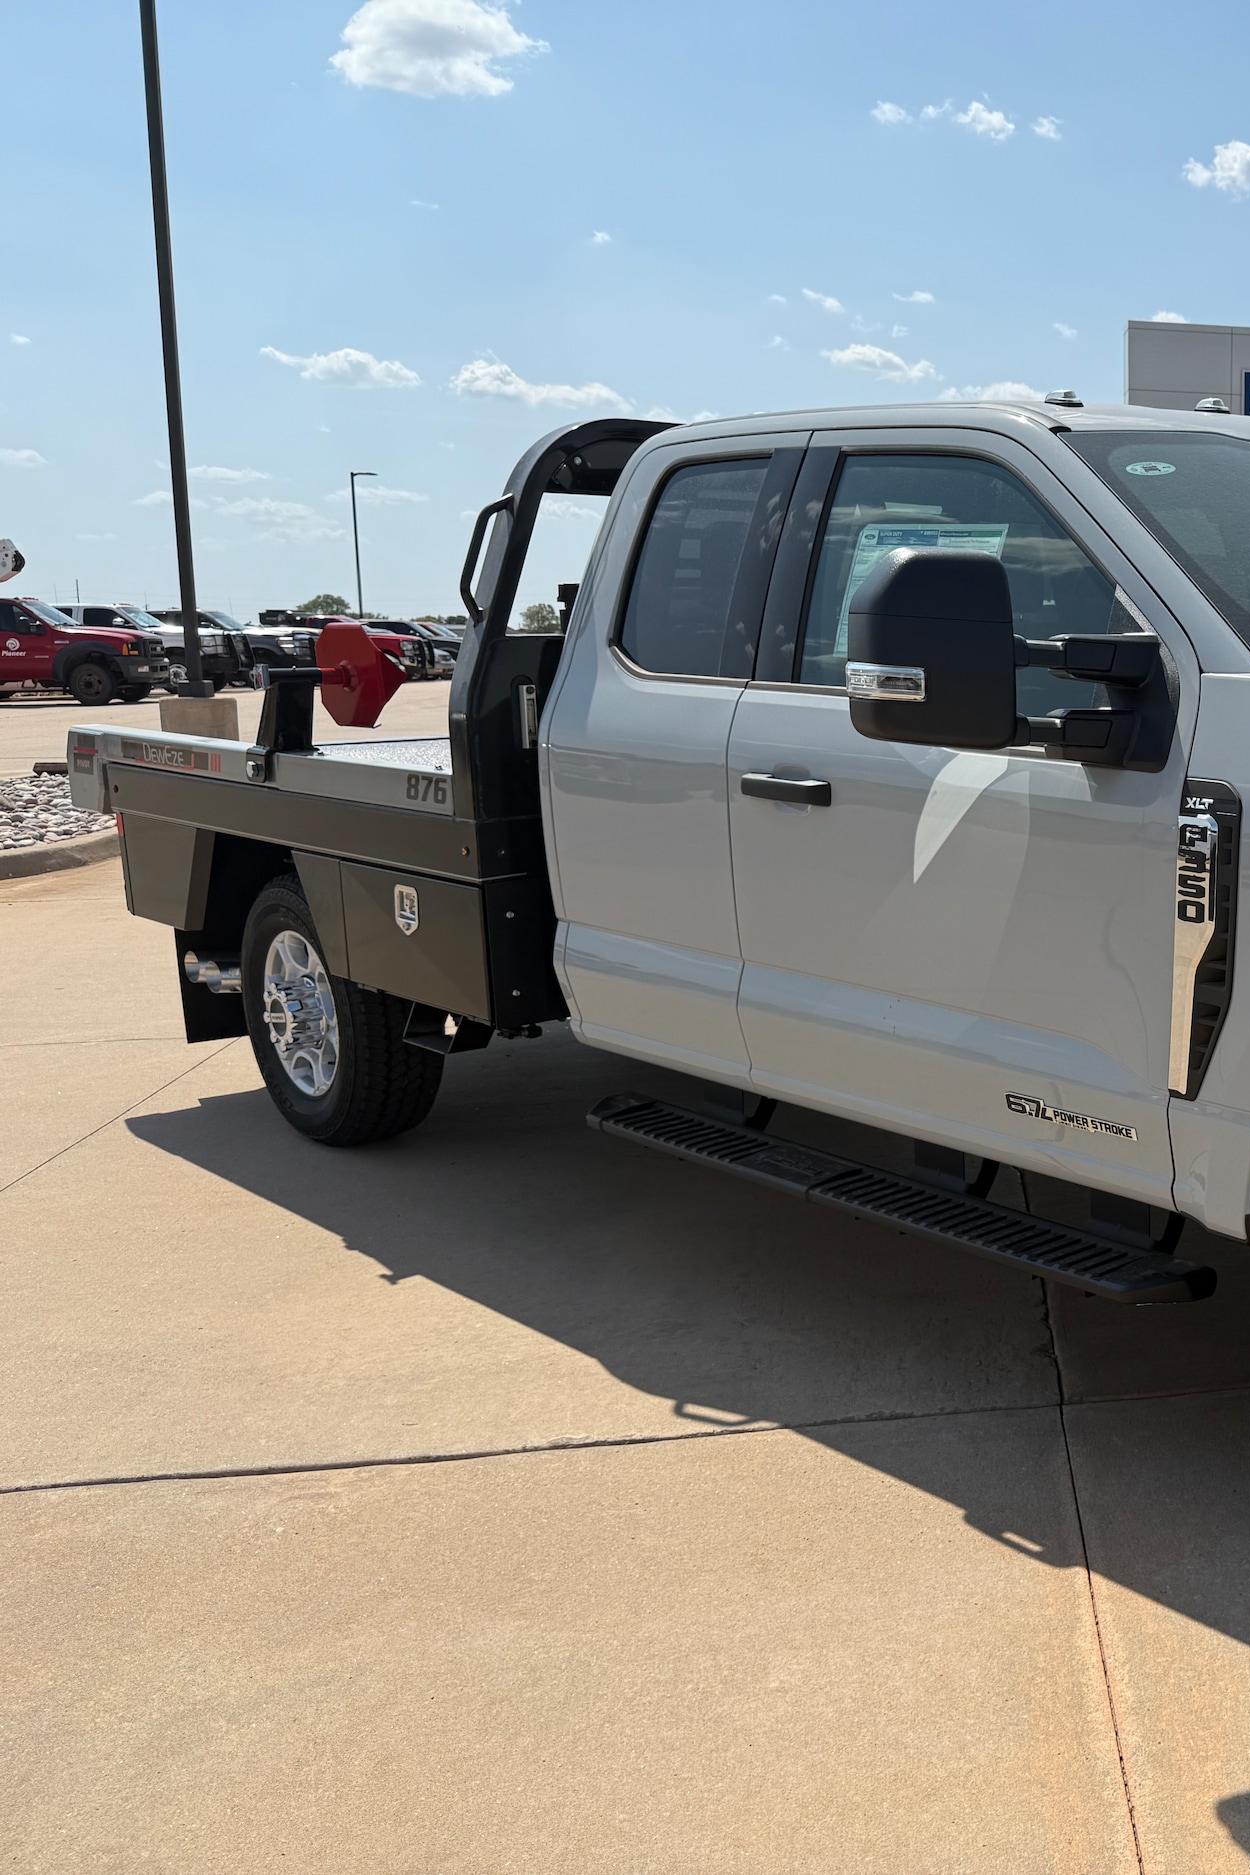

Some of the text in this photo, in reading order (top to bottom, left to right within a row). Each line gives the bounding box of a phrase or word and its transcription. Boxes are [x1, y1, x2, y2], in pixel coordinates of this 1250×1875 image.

[406, 773, 448, 805] 876
[1185, 797, 1214, 810] XLT
[1052, 1109, 1089, 1129] POWER
[1090, 1119, 1134, 1139] STROKE
